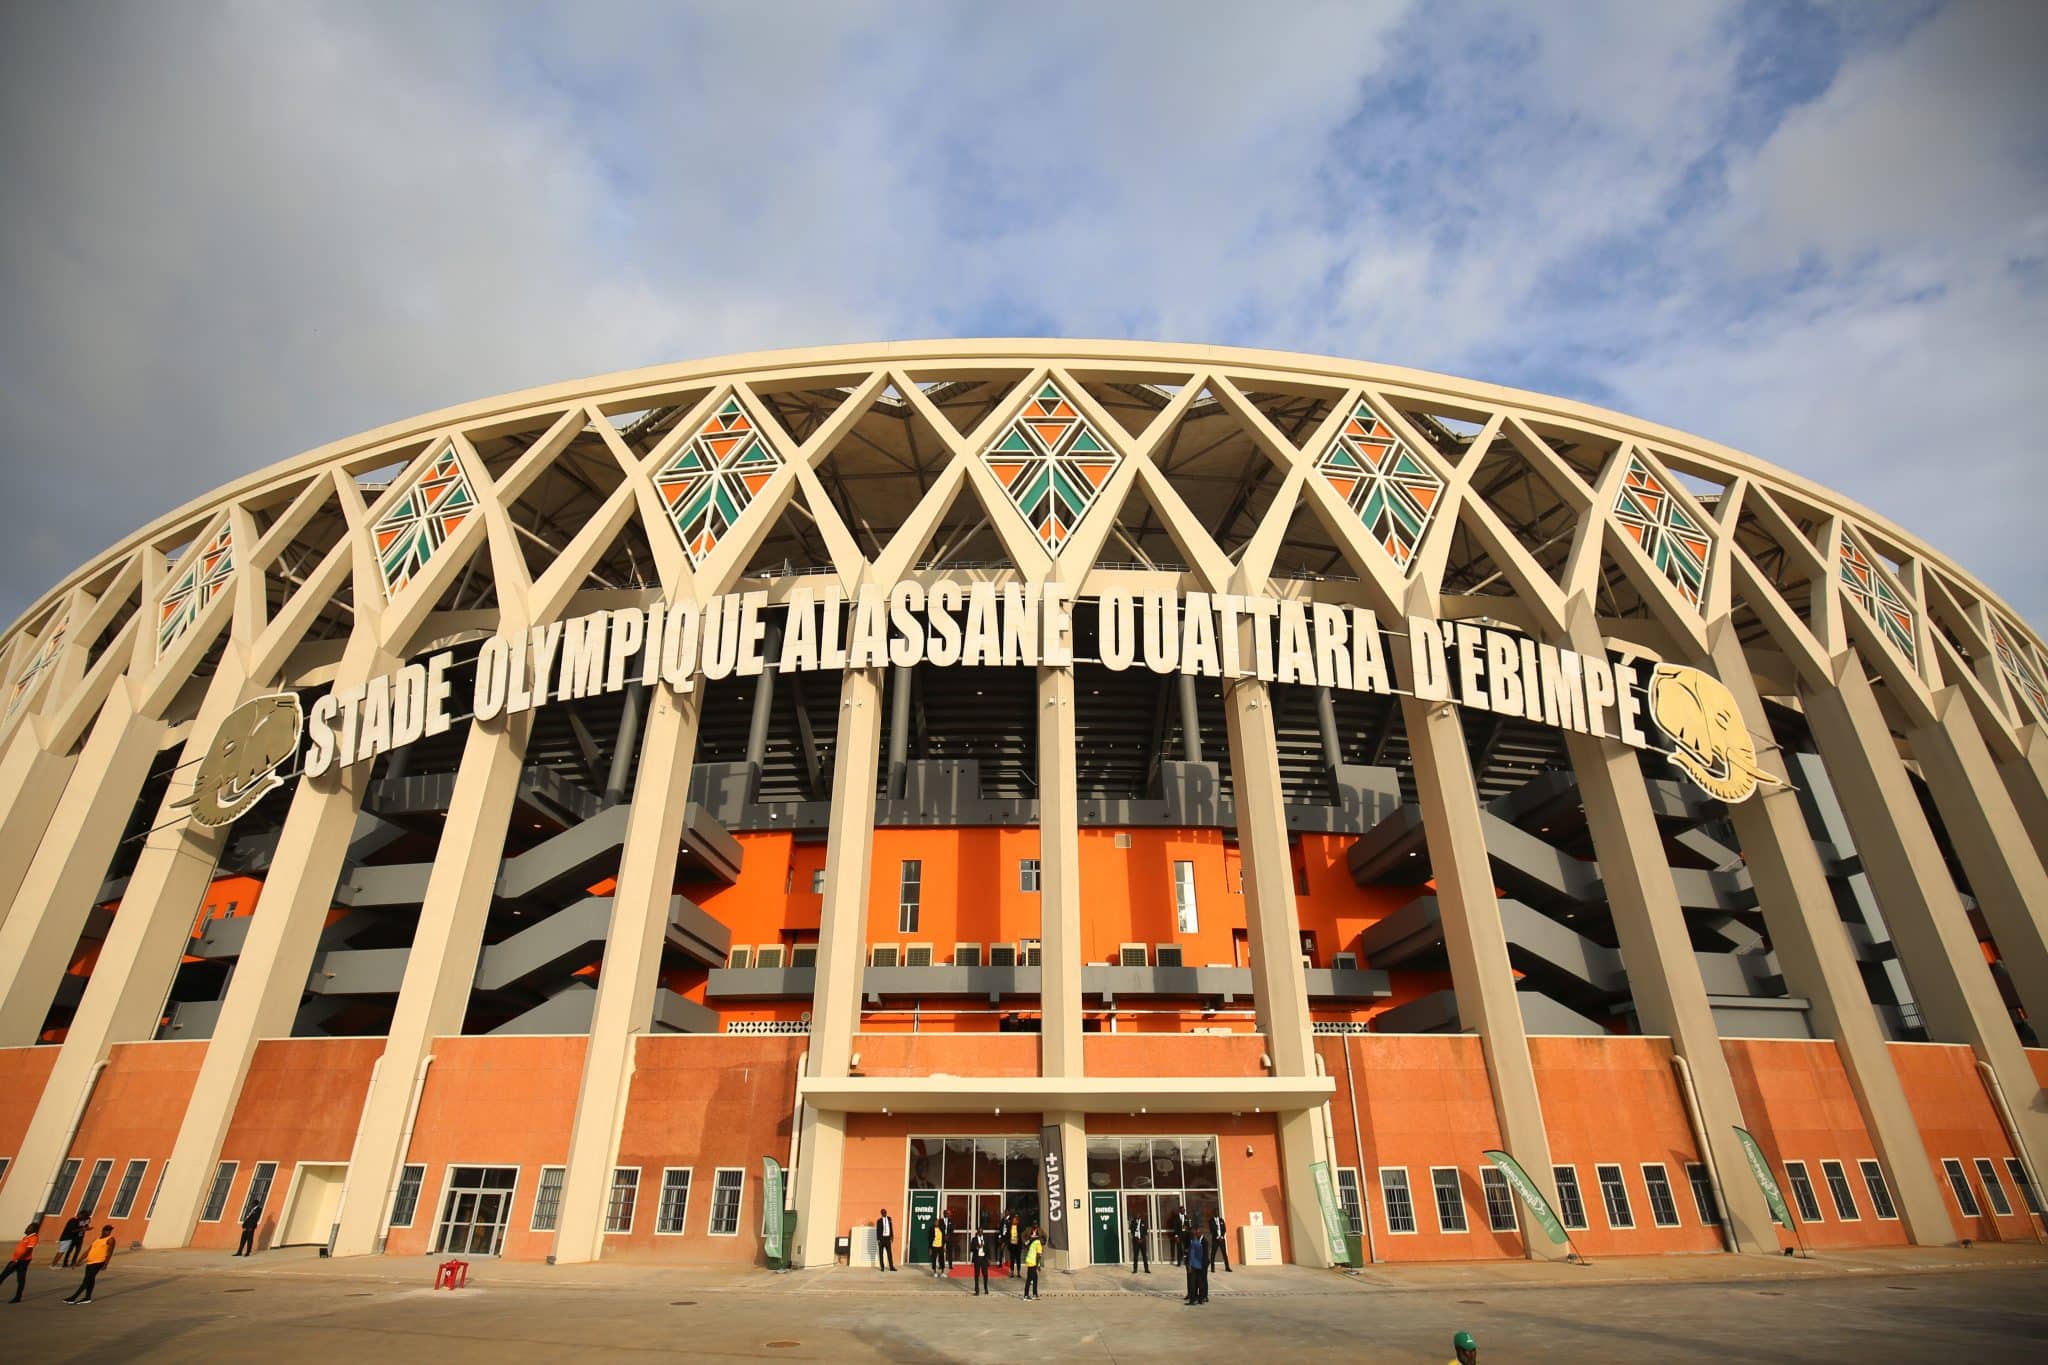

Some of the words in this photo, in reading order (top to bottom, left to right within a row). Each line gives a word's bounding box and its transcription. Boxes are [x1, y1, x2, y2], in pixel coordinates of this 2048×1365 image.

[304, 651, 454, 778] STADE
[473, 590, 766, 721] OLYMPIQUE
[779, 580, 1071, 673] ALASSANE
[1099, 586, 1390, 695] OUATTARA
[1408, 615, 1646, 748] D'EBIMPE
